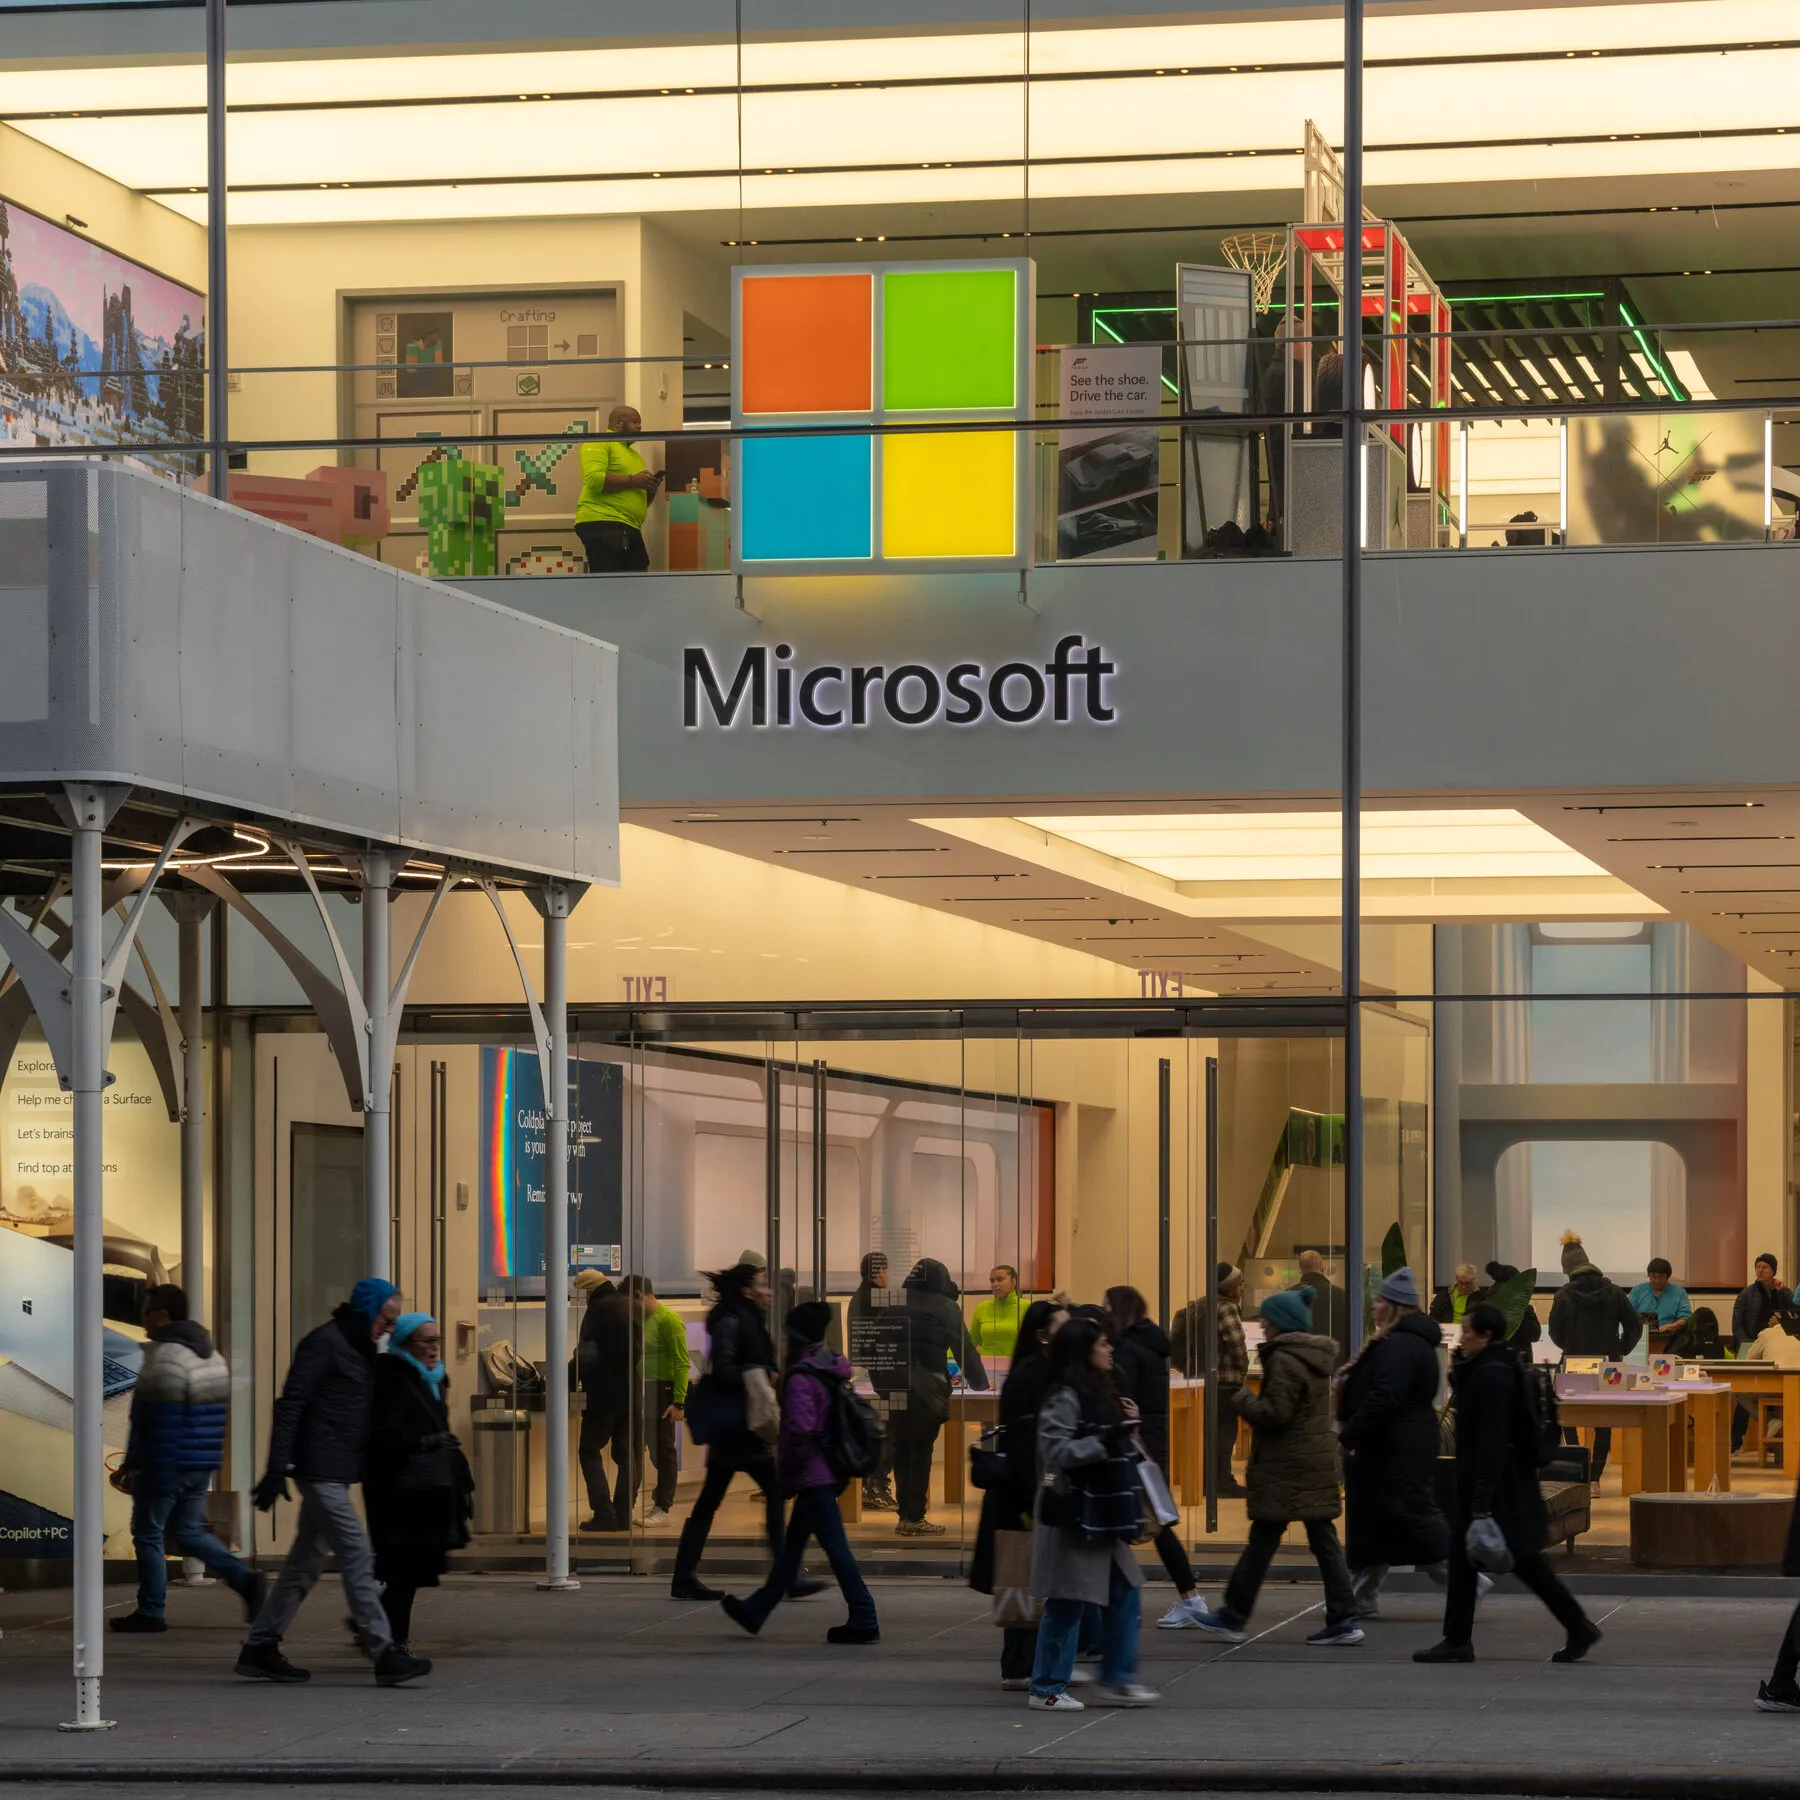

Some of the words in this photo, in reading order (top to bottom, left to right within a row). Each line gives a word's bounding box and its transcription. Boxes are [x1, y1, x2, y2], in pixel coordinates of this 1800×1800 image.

[500, 309, 556, 323] Crafting
[1070, 375, 1092, 386] See
[1095, 373, 1115, 386] the
[1118, 373, 1149, 385] shoe.
[1070, 390, 1101, 402] Drive
[1104, 389, 1124, 401] the
[1126, 391, 1148, 401] car.
[684, 635, 1115, 727] Microsoft
[17, 1060, 56, 1074] Explore
[17, 1094, 42, 1107] Help
[44, 1096, 61, 1105] me
[103, 1097, 110, 1105] a
[112, 1093, 152, 1105] Surface
[518, 1109, 545, 1135] Coldpla
[571, 1115, 592, 1138] poject
[17, 1129, 41, 1140] Let's
[43, 1128, 74, 1140] brains
[525, 1134, 531, 1153] is
[17, 1162, 39, 1173] Find
[42, 1164, 60, 1176] top
